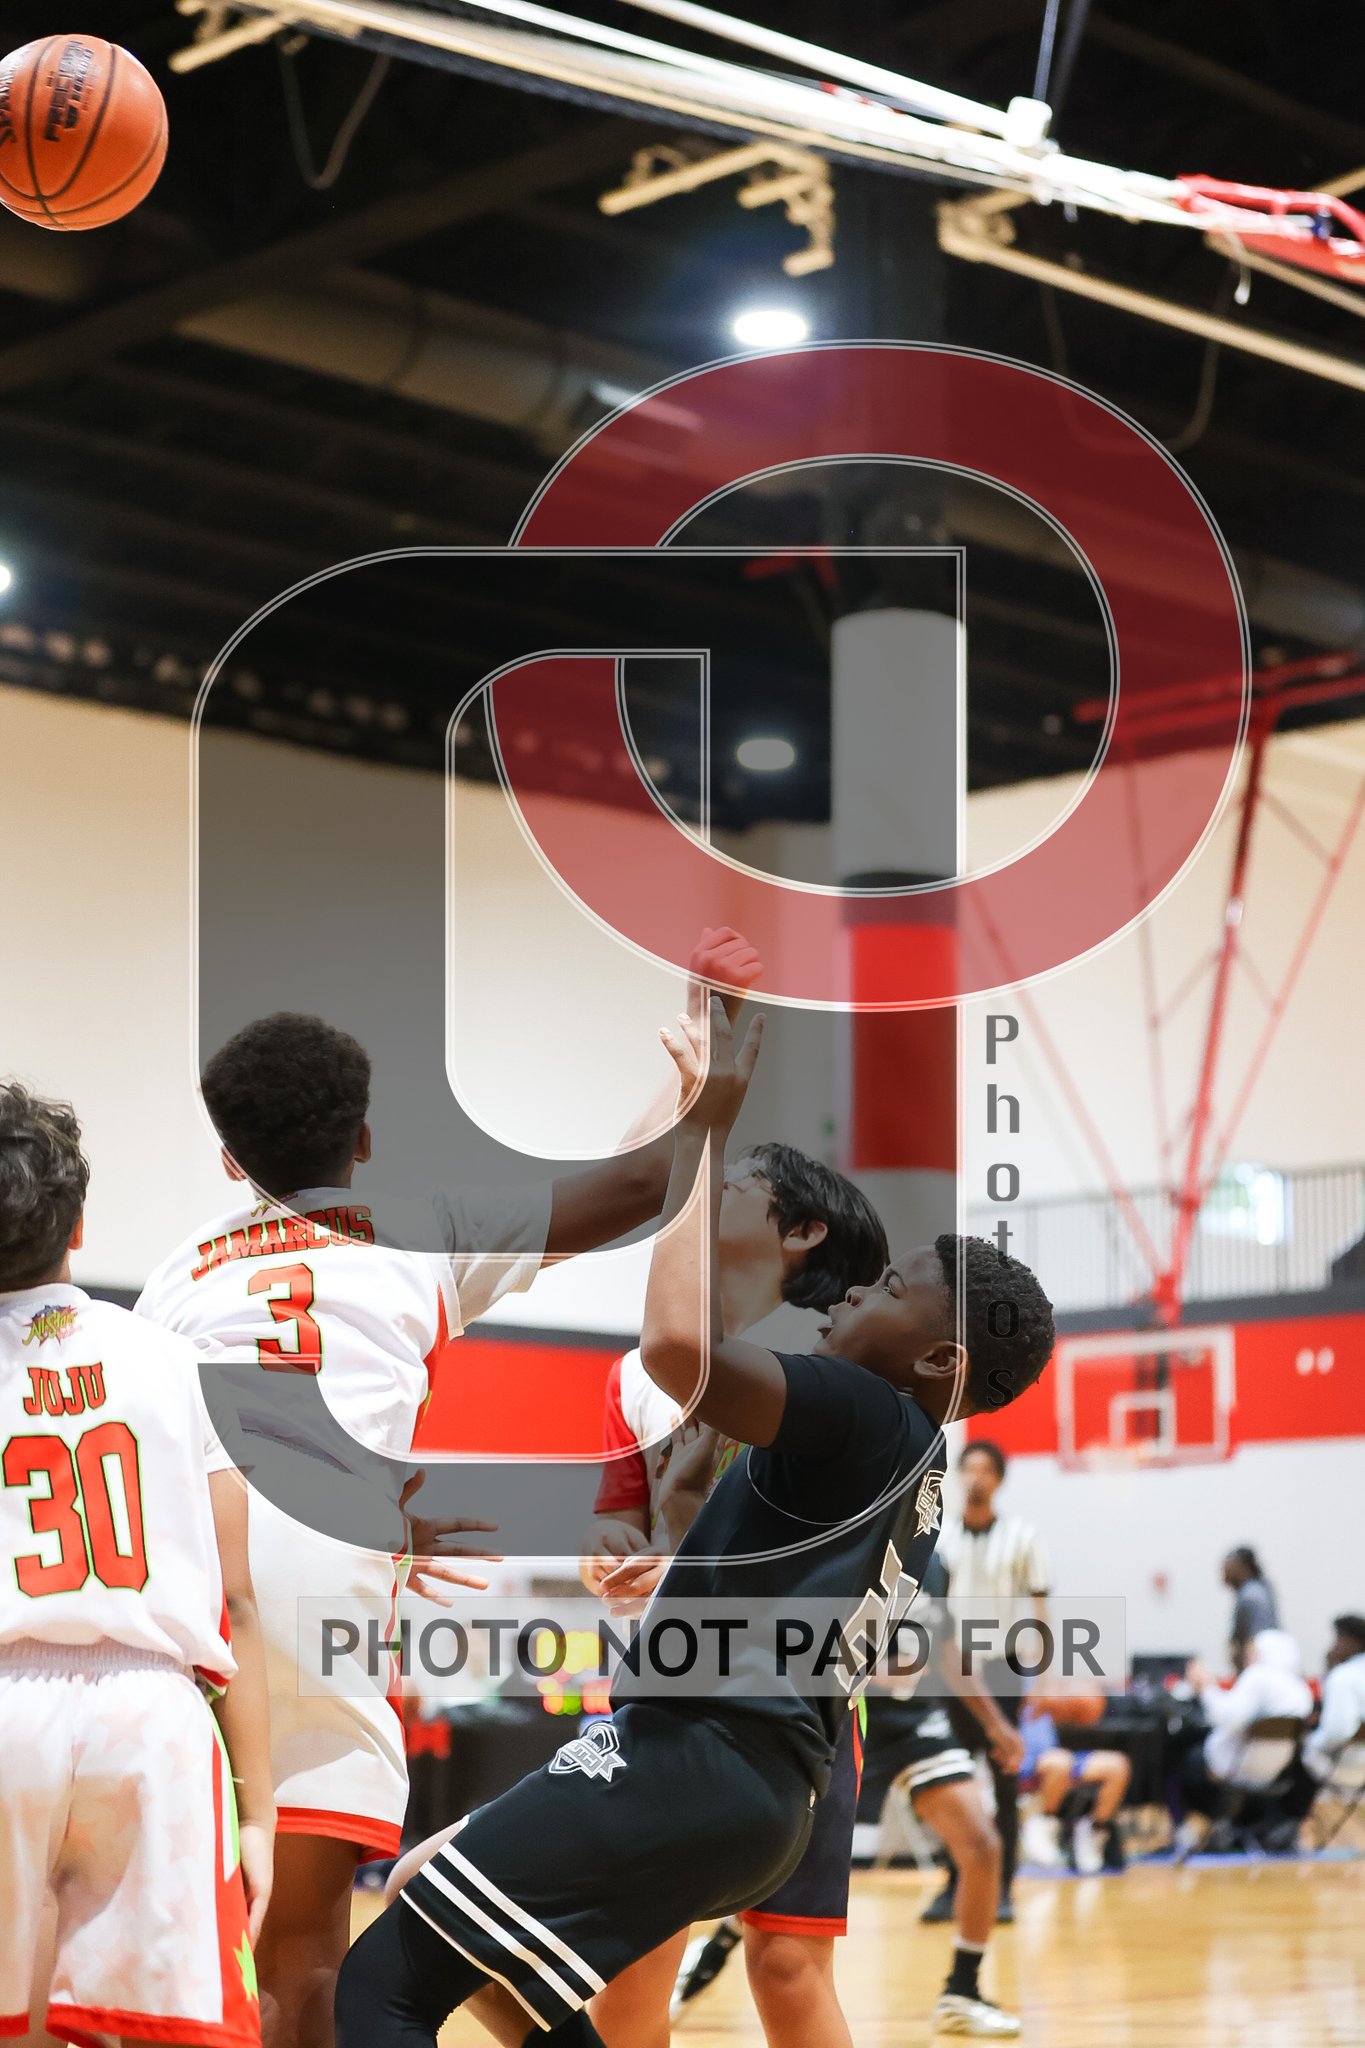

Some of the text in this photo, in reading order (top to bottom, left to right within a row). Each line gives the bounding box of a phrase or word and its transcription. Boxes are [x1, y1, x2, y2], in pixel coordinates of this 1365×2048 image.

[191, 1206, 375, 1281] JAMARCUS
[248, 1263, 322, 1375] 3
[23, 1361, 107, 1416] JUJU
[2, 1422, 149, 1597] 30
